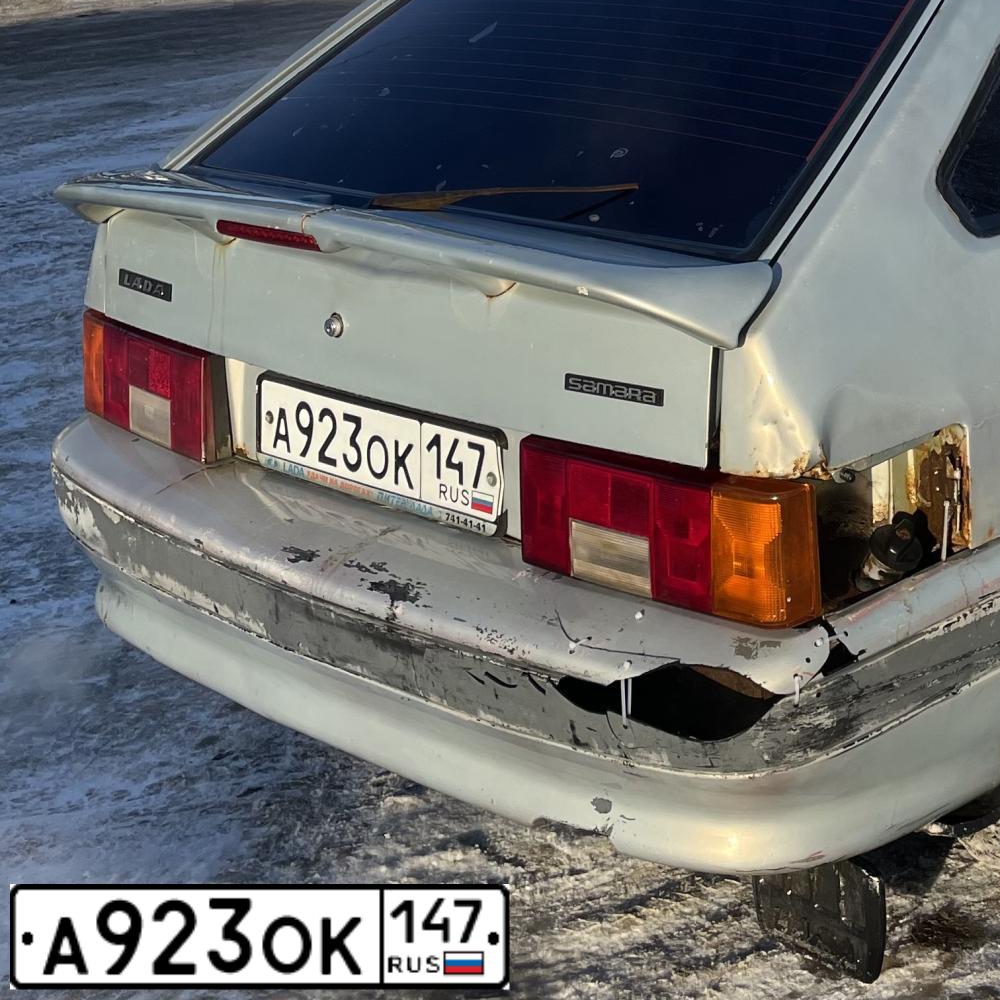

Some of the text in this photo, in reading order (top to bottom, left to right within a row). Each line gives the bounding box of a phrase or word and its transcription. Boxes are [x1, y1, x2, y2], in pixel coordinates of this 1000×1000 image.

[123, 273, 165, 296] LADA
[426, 433, 485, 489] 147
[282, 461, 305, 477] LADA
[445, 512, 486, 532] 741-41-41
[439, 483, 470, 507] RUS
